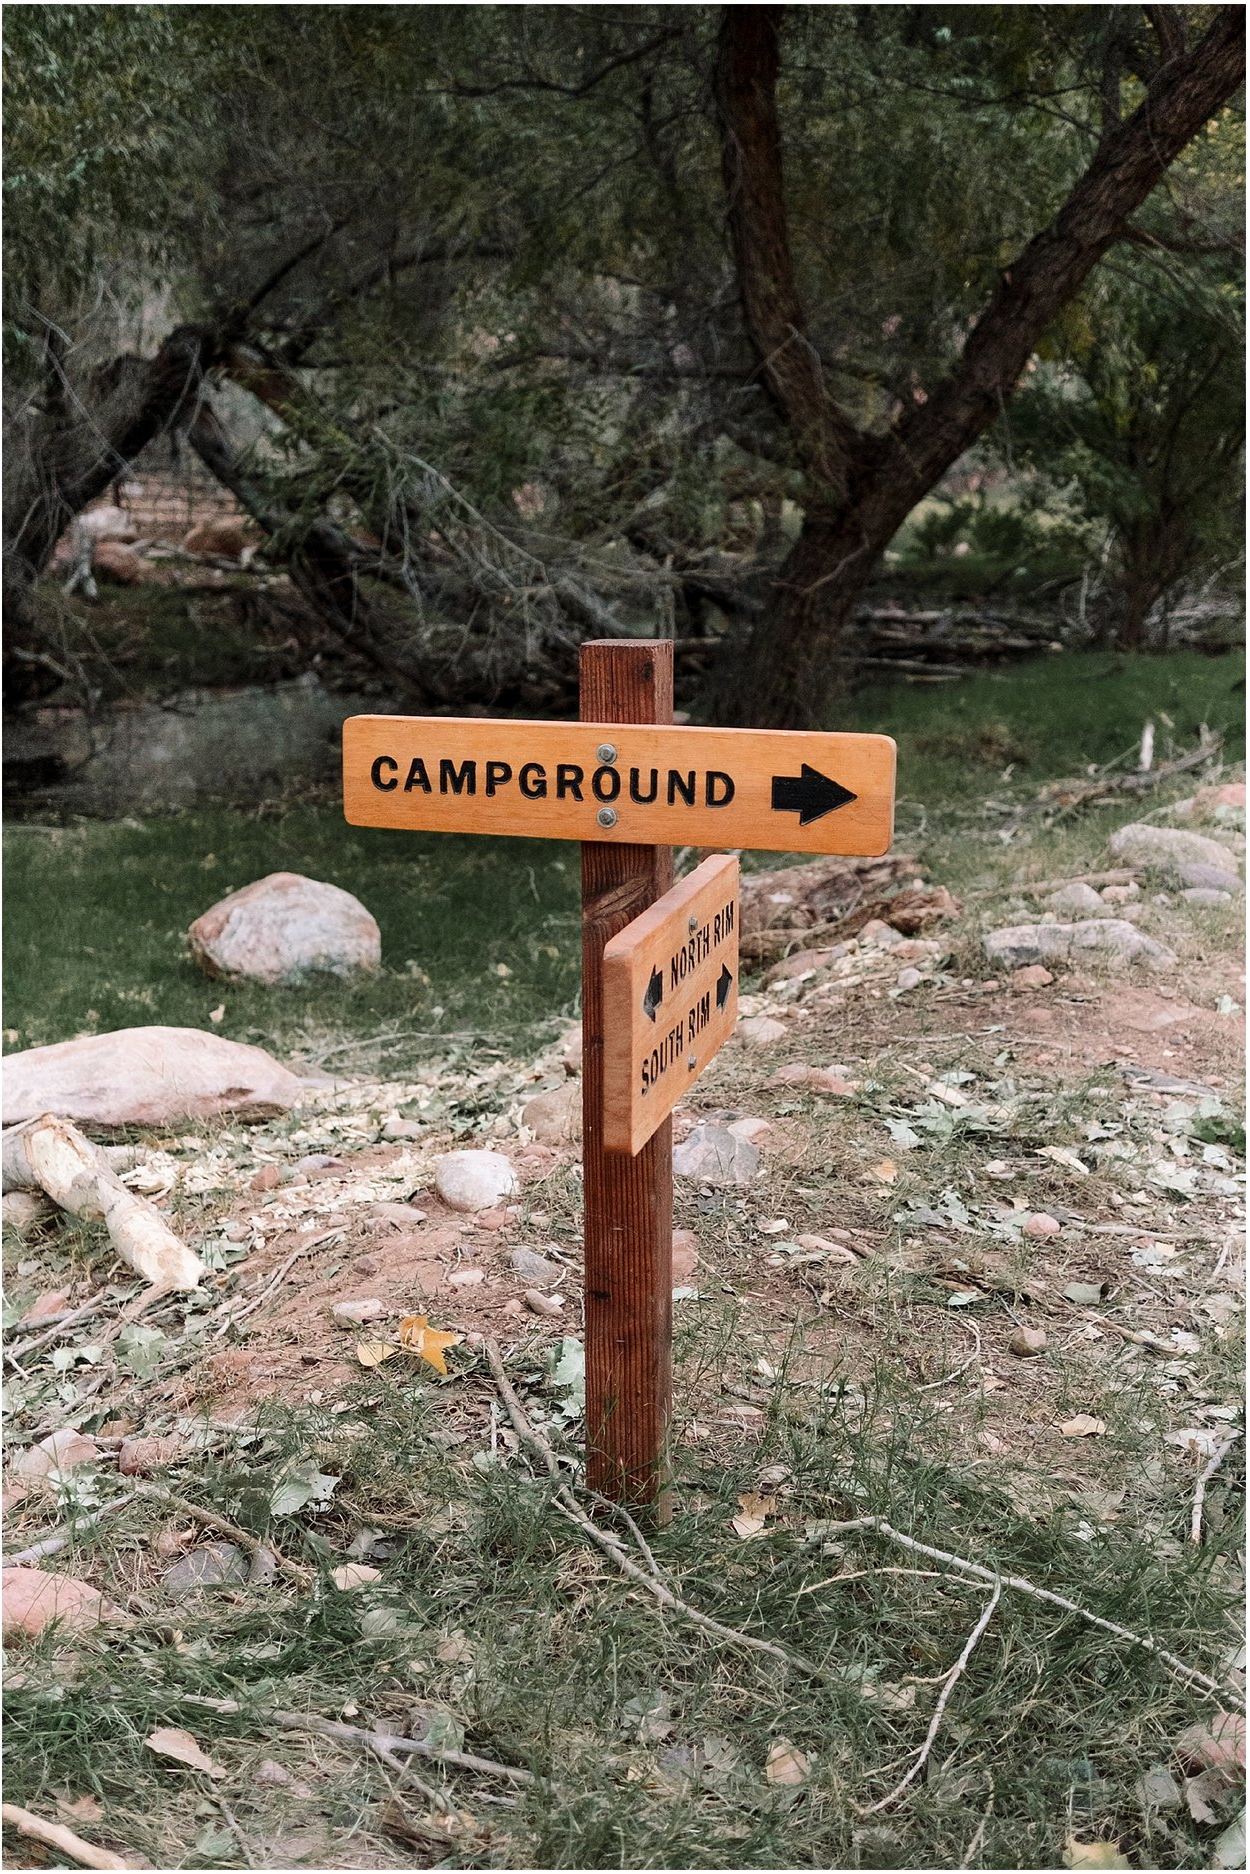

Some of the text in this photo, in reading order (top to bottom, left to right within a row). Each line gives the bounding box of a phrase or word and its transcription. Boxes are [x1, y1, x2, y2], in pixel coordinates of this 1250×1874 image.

[370, 755, 736, 808] CAMPGROUND
[671, 900, 735, 991] NORTH RIM
[641, 991, 710, 1097] SOUTH RIM
